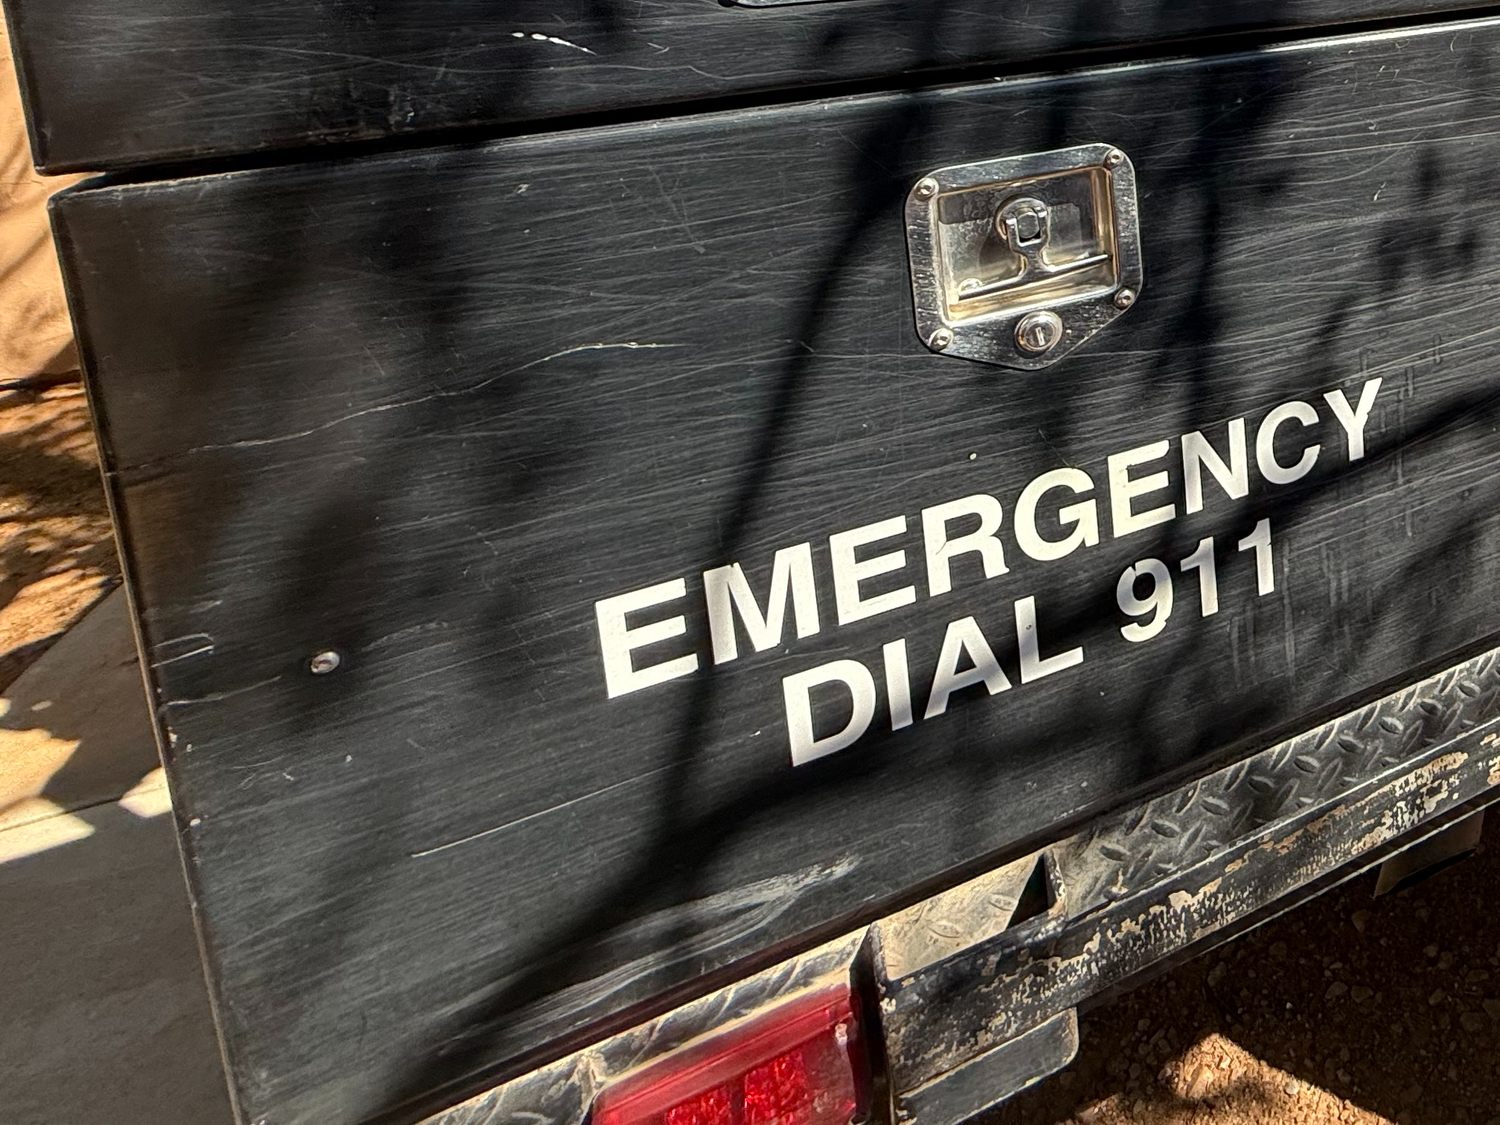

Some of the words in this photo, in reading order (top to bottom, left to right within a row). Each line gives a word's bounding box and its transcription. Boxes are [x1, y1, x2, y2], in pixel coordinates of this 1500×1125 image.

[595, 377, 1384, 699] EMERGENCY
[782, 596, 1084, 767] DIAL
[1116, 519, 1275, 642] 911
